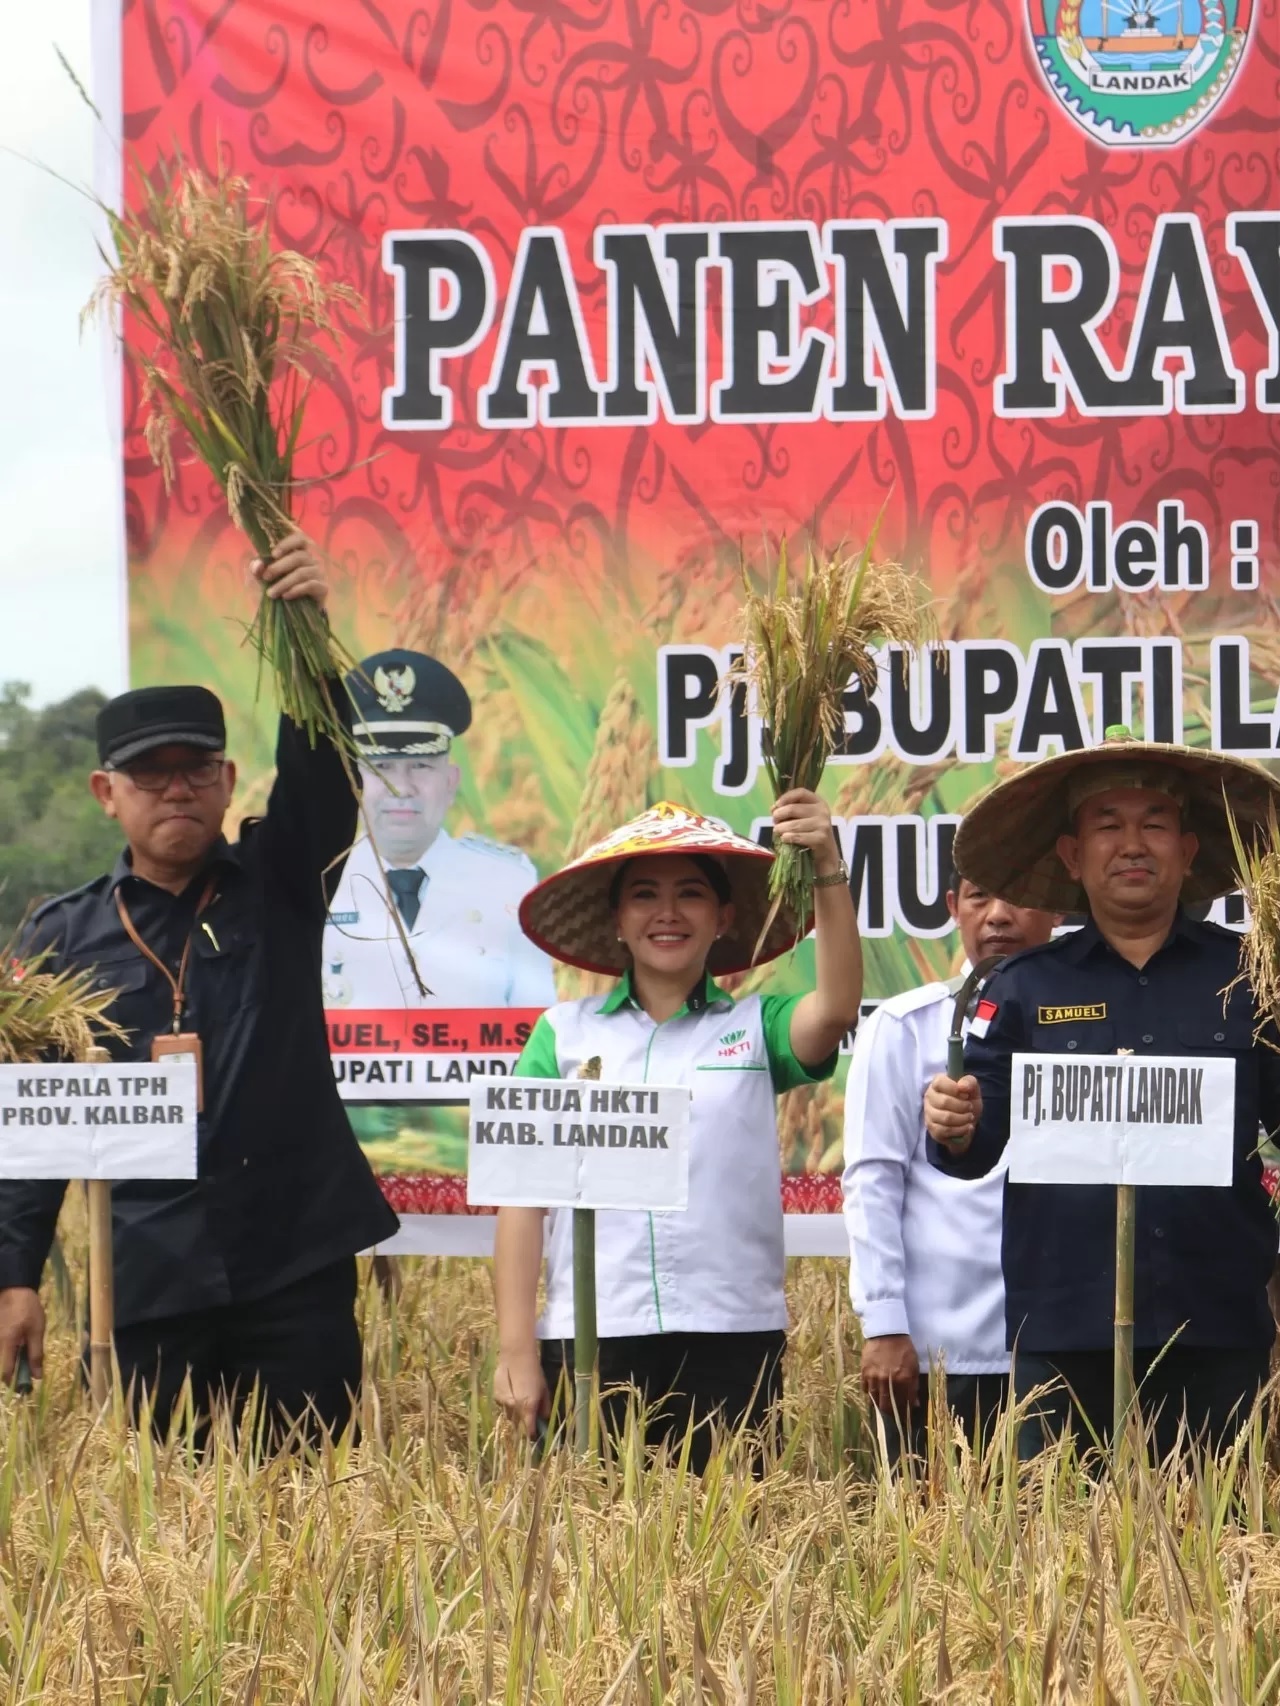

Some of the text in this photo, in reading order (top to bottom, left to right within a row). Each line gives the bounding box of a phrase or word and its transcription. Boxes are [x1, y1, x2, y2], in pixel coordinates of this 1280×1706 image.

[1091, 72, 1190, 90] LANDAK
[385, 222, 944, 427] PANEN
[1030, 504, 1207, 592] Oleh
[1045, 1007, 1100, 1020] SAMUEL
[326, 1021, 533, 1052] UEL, SE., M.S
[718, 1041, 751, 1057] HKTI
[332, 1059, 517, 1084] UPATI LAND
[17, 1076, 168, 1097] KEPALA TPH
[1022, 1063, 1204, 1126] Pj. BUPATI LANDAK
[487, 1086, 659, 1115] KETUA HKTI
[2, 1105, 184, 1126] PROV. KALBAR
[475, 1121, 669, 1150] KAB. LANDAK
